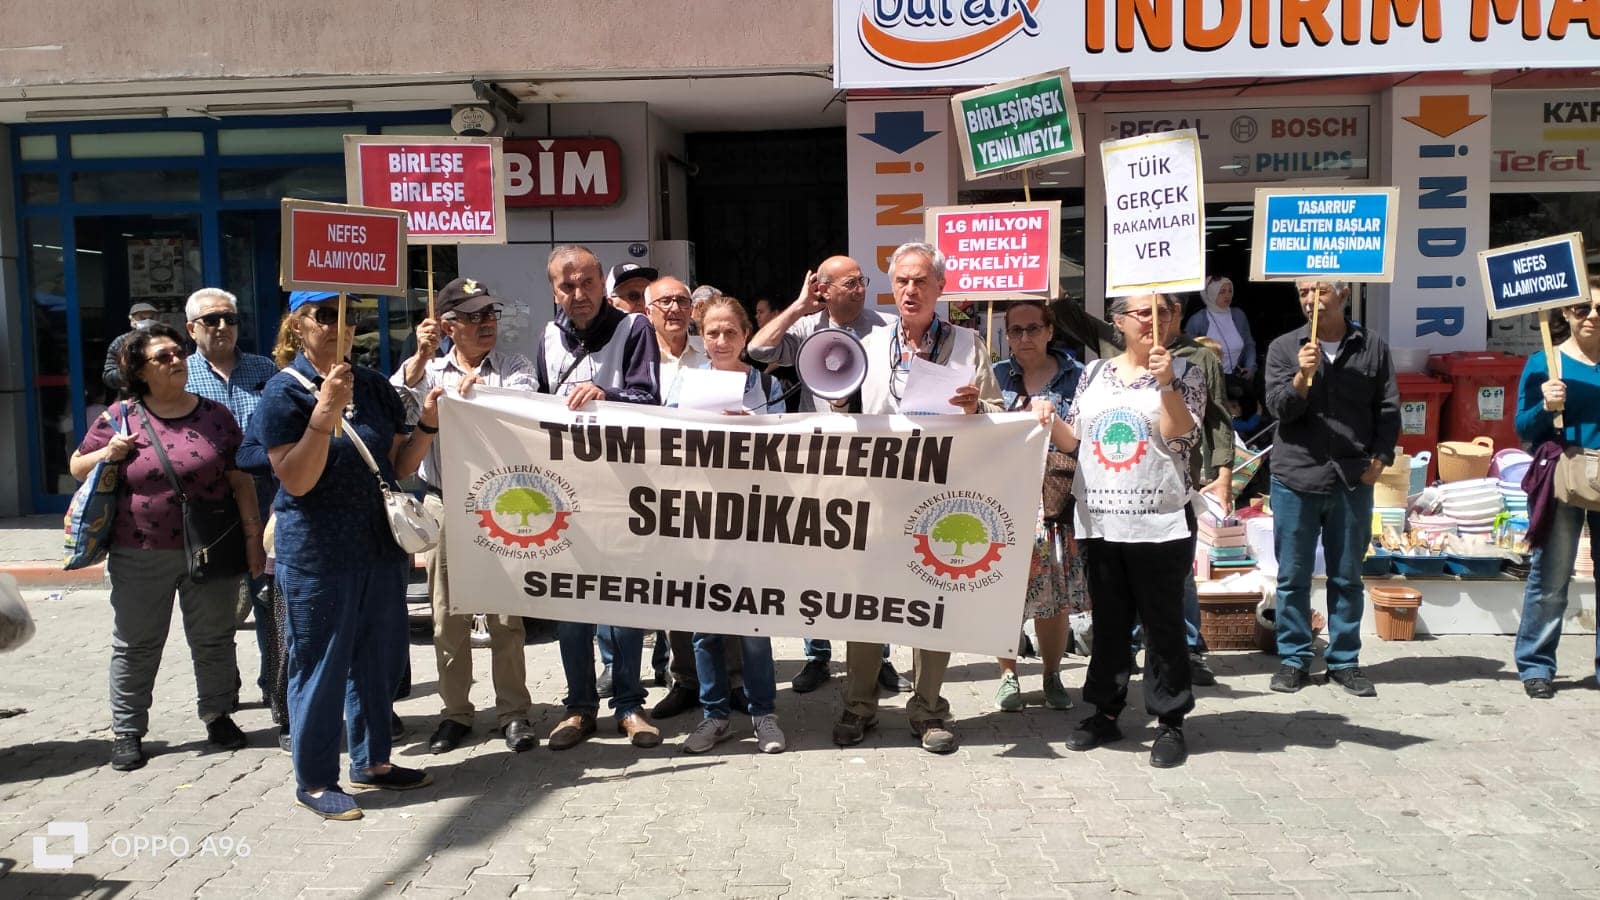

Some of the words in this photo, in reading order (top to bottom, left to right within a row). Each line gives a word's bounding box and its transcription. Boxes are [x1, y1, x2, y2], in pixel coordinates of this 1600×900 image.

[967, 89, 1063, 134] BİRLEŞİRSEK
[1271, 117, 1357, 138] BOSCH
[976, 121, 1065, 165] YENİLMEYİZ
[388, 147, 464, 178] BİRLEŞE
[504, 139, 609, 197] BİM
[1127, 155, 1171, 179] TÜİK
[1256, 151, 1353, 172] PHILIPS
[1493, 149, 1592, 172] Tefal
[390, 177, 465, 207] BİRLEŞE
[1116, 185, 1189, 211] GERÇEK
[407, 205, 492, 231] ANACAĞIZ
[1298, 200, 1356, 215] TASARRUF
[327, 223, 368, 245] NEFES
[944, 220, 967, 234] 16
[972, 215, 1043, 233] MİLYON
[1113, 213, 1196, 235] RAKAMLARI
[1272, 218, 1333, 233] DEVLETTEN
[1335, 217, 1381, 236] BAŞLAR
[958, 233, 1028, 252] EMEKLİ
[1135, 241, 1171, 260] VER
[1270, 233, 1311, 251] EMEKLİ
[1312, 235, 1381, 254] MAAŞINDAN
[307, 249, 387, 272] ALAMIYORUZ
[945, 253, 1041, 271] ÖFKELİYİZ
[1306, 252, 1340, 269] DEĞİL
[1513, 254, 1548, 276] NEFES
[958, 274, 1025, 290] ÖFKELİ
[1502, 271, 1568, 298] ALAMIYORUZ
[539, 414, 646, 465] TÜM
[660, 426, 954, 485] EMEKLİLERİN
[464, 492, 476, 515] TÜM
[473, 464, 542, 491] EMEKLİLERİN
[543, 469, 581, 513] SENDİKASI
[628, 484, 871, 551] SENDİKASI
[904, 515, 918, 536] TÜM
[914, 490, 985, 515] EMEKLİLERİN
[985, 496, 1016, 546] SENDİKASI
[539, 537, 573, 560] ŞUBESİ
[968, 569, 1004, 592] ŞUBESİ
[523, 570, 786, 616] SEFERİHİSAR
[799, 588, 945, 630] ŞUBESİ
